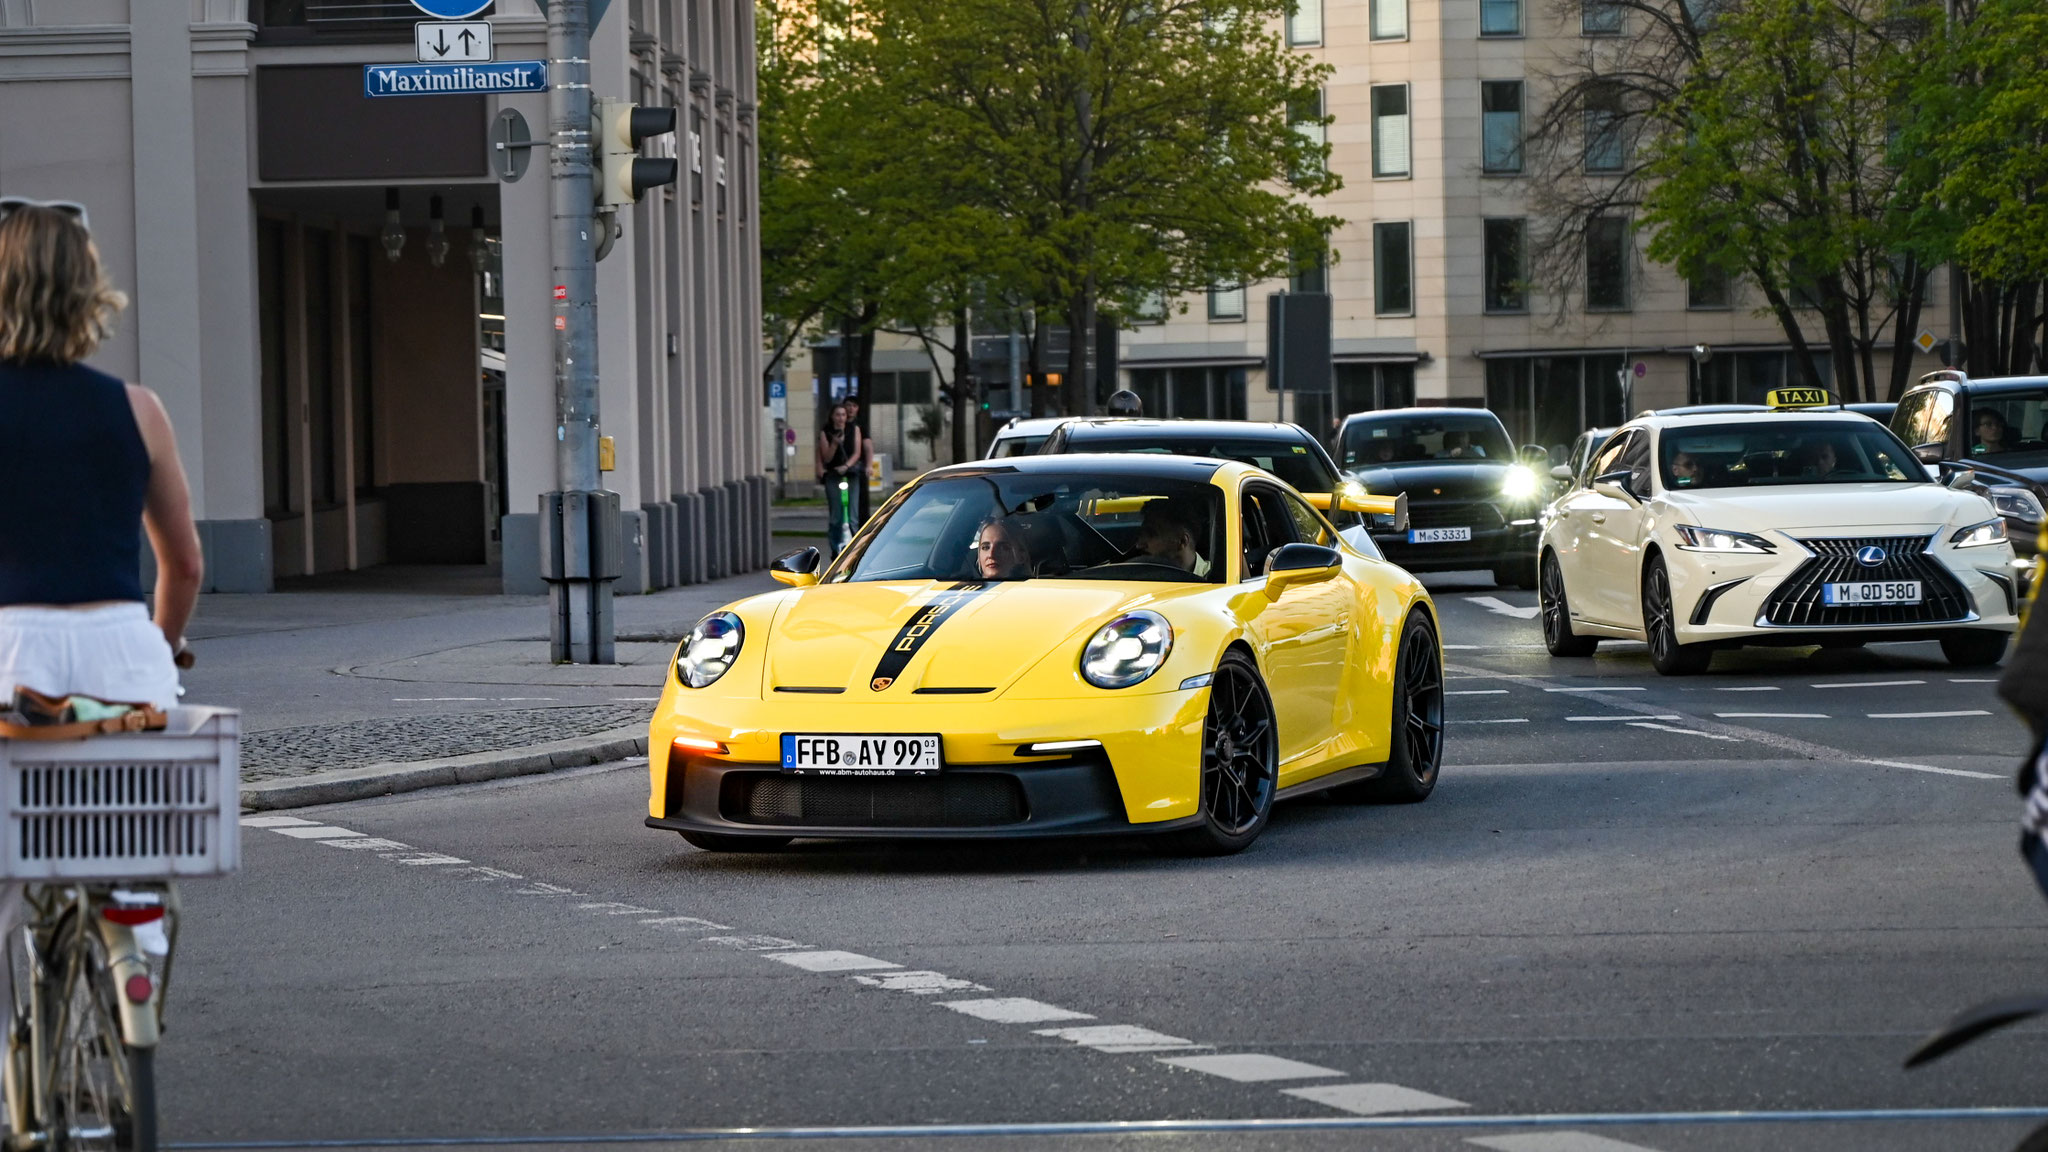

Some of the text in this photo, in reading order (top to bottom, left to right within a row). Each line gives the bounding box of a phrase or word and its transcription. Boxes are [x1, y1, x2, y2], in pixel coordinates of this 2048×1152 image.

[378, 67, 535, 92] Maximilianstr.
[1780, 391, 1820, 402] TAXI
[1419, 530, 1467, 541] M S 3331
[1840, 583, 1915, 600] M QD 580
[894, 584, 983, 651] PORSCHE
[786, 755, 793, 763] D
[797, 739, 922, 766] FFB AY 99
[926, 758, 935, 766] 11
